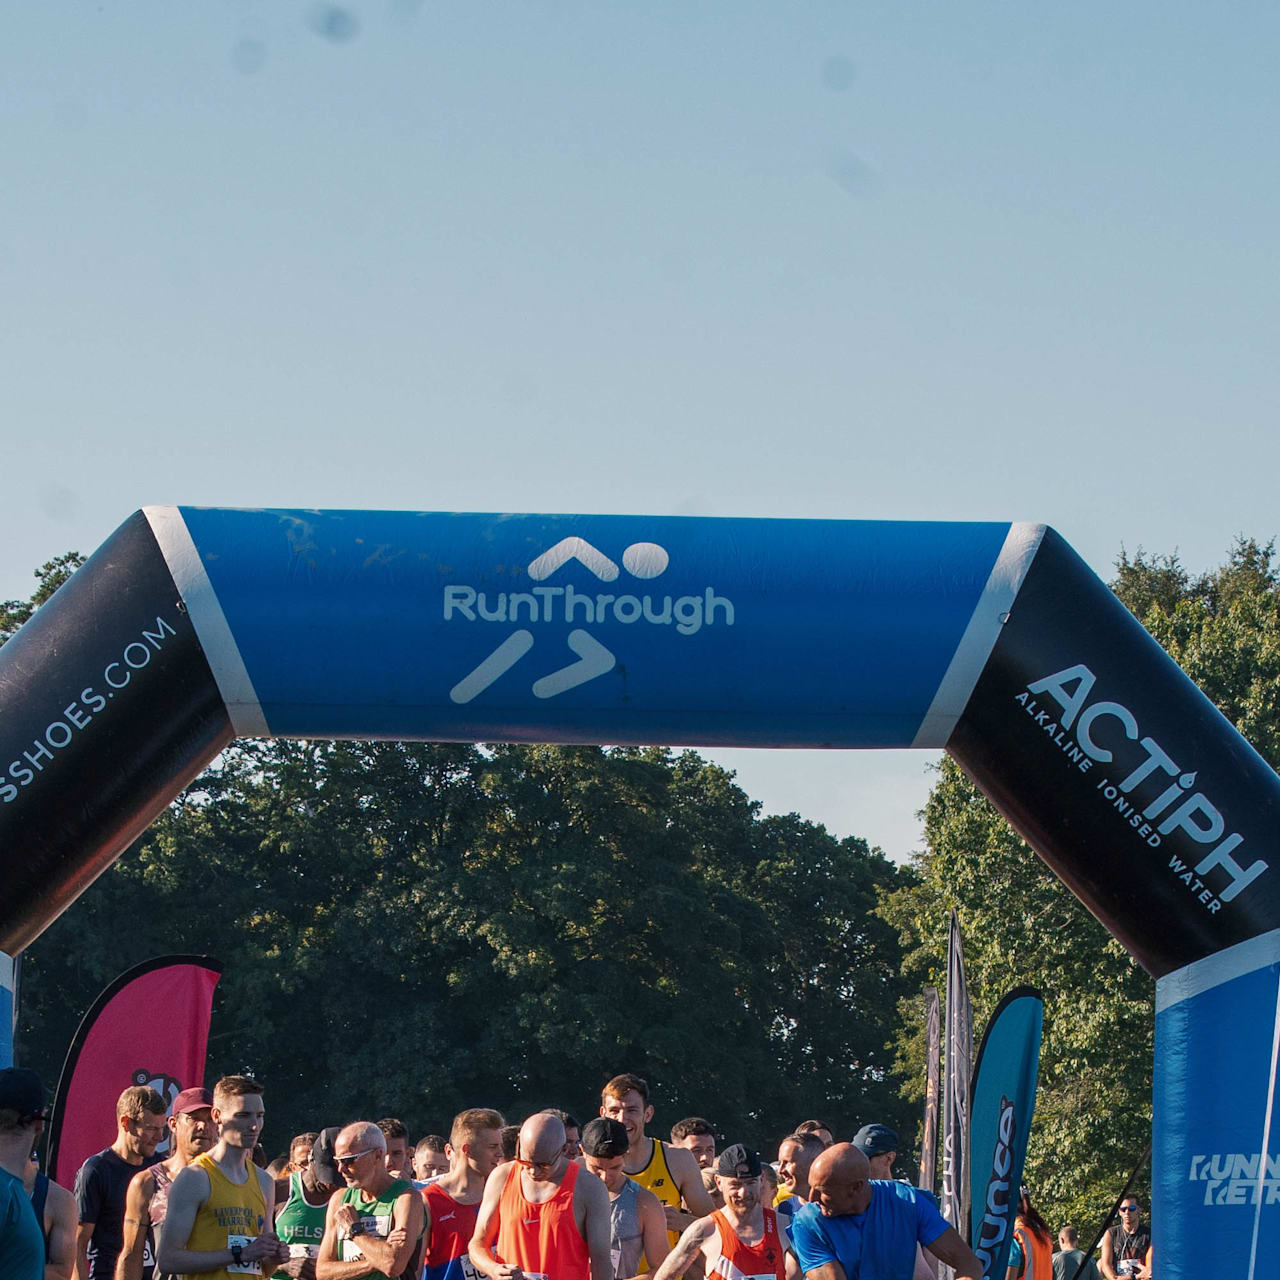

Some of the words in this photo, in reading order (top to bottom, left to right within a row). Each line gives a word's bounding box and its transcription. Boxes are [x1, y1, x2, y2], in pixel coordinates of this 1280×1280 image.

[444, 584, 734, 635] RunThrough
[1015, 691, 1093, 774] ALKALINE
[1097, 778, 1162, 848] IONISED
[1168, 854, 1221, 915] WATER
[283, 1225, 323, 1239] HELS
